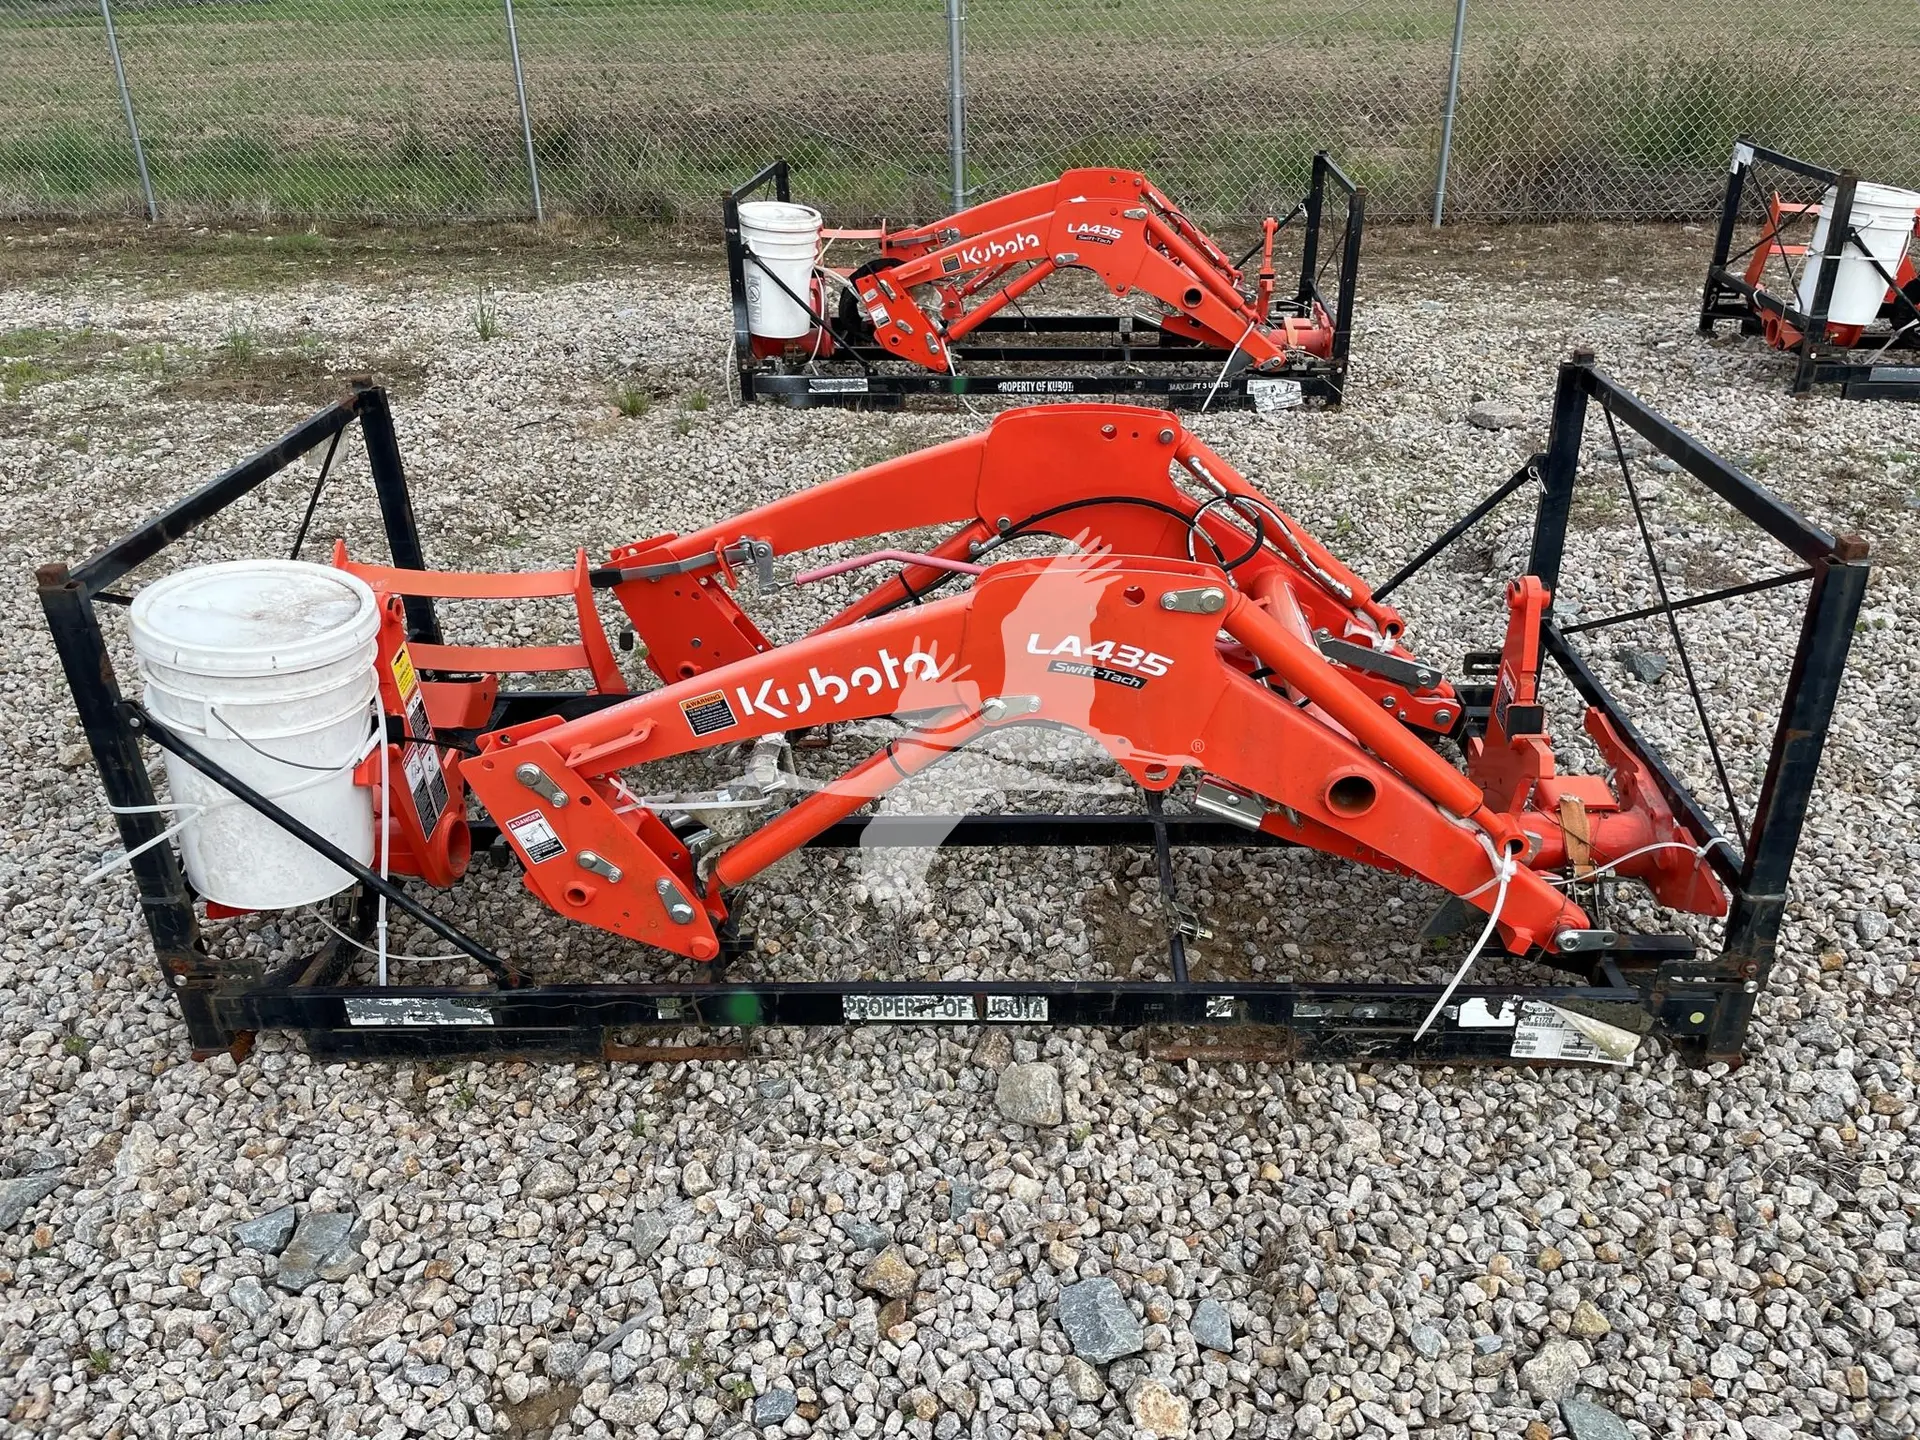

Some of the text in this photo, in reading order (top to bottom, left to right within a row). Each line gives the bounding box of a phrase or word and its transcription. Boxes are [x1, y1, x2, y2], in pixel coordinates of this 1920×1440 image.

[1067, 223, 1123, 239] LA435
[961, 233, 1040, 265] Kubota
[998, 381, 1035, 392] PROPERTY
[1036, 381, 1046, 392] OF
[1027, 633, 1175, 676] LA435
[736, 649, 940, 719] Kubota
[1053, 662, 1141, 687] Swift-Tach
[690, 693, 721, 707] WARNING
[515, 812, 541, 826] DANGER
[846, 998, 938, 1018] PROPERTY
[943, 998, 968, 1017] OF
